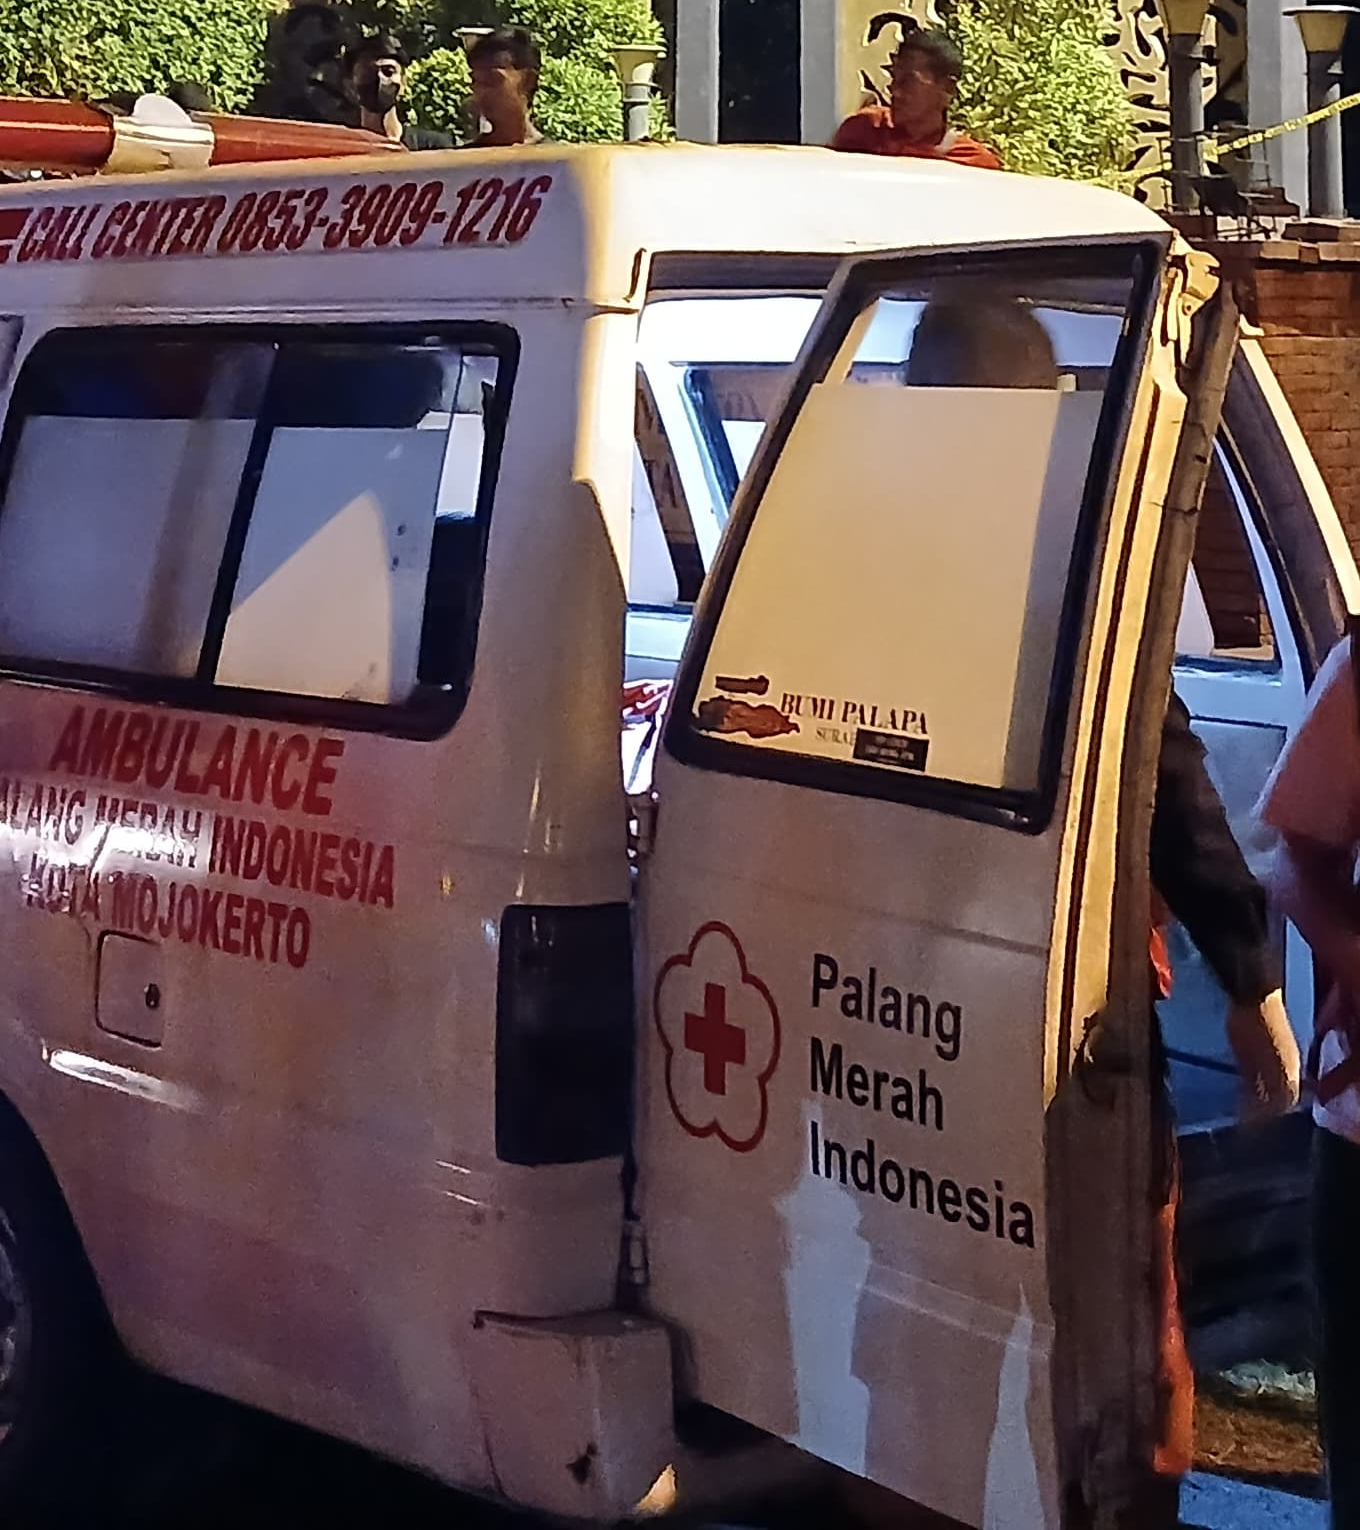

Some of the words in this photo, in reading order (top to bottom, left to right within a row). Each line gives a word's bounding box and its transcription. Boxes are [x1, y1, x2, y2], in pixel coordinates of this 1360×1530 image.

[17, 203, 102, 262] CALL
[91, 194, 227, 259] CENTER
[217, 175, 552, 252] 0853-3909-1216
[50, 705, 345, 815] AMBULANCE
[781, 693, 835, 720] BUMI
[841, 701, 928, 734] PALAPA
[207, 813, 395, 908] INDONESIA
[110, 870, 311, 969] MOJOKERTO
[811, 953, 962, 1061] Palang
[809, 1036, 944, 1131] Merah
[810, 1120, 1037, 1249] Indonesia
